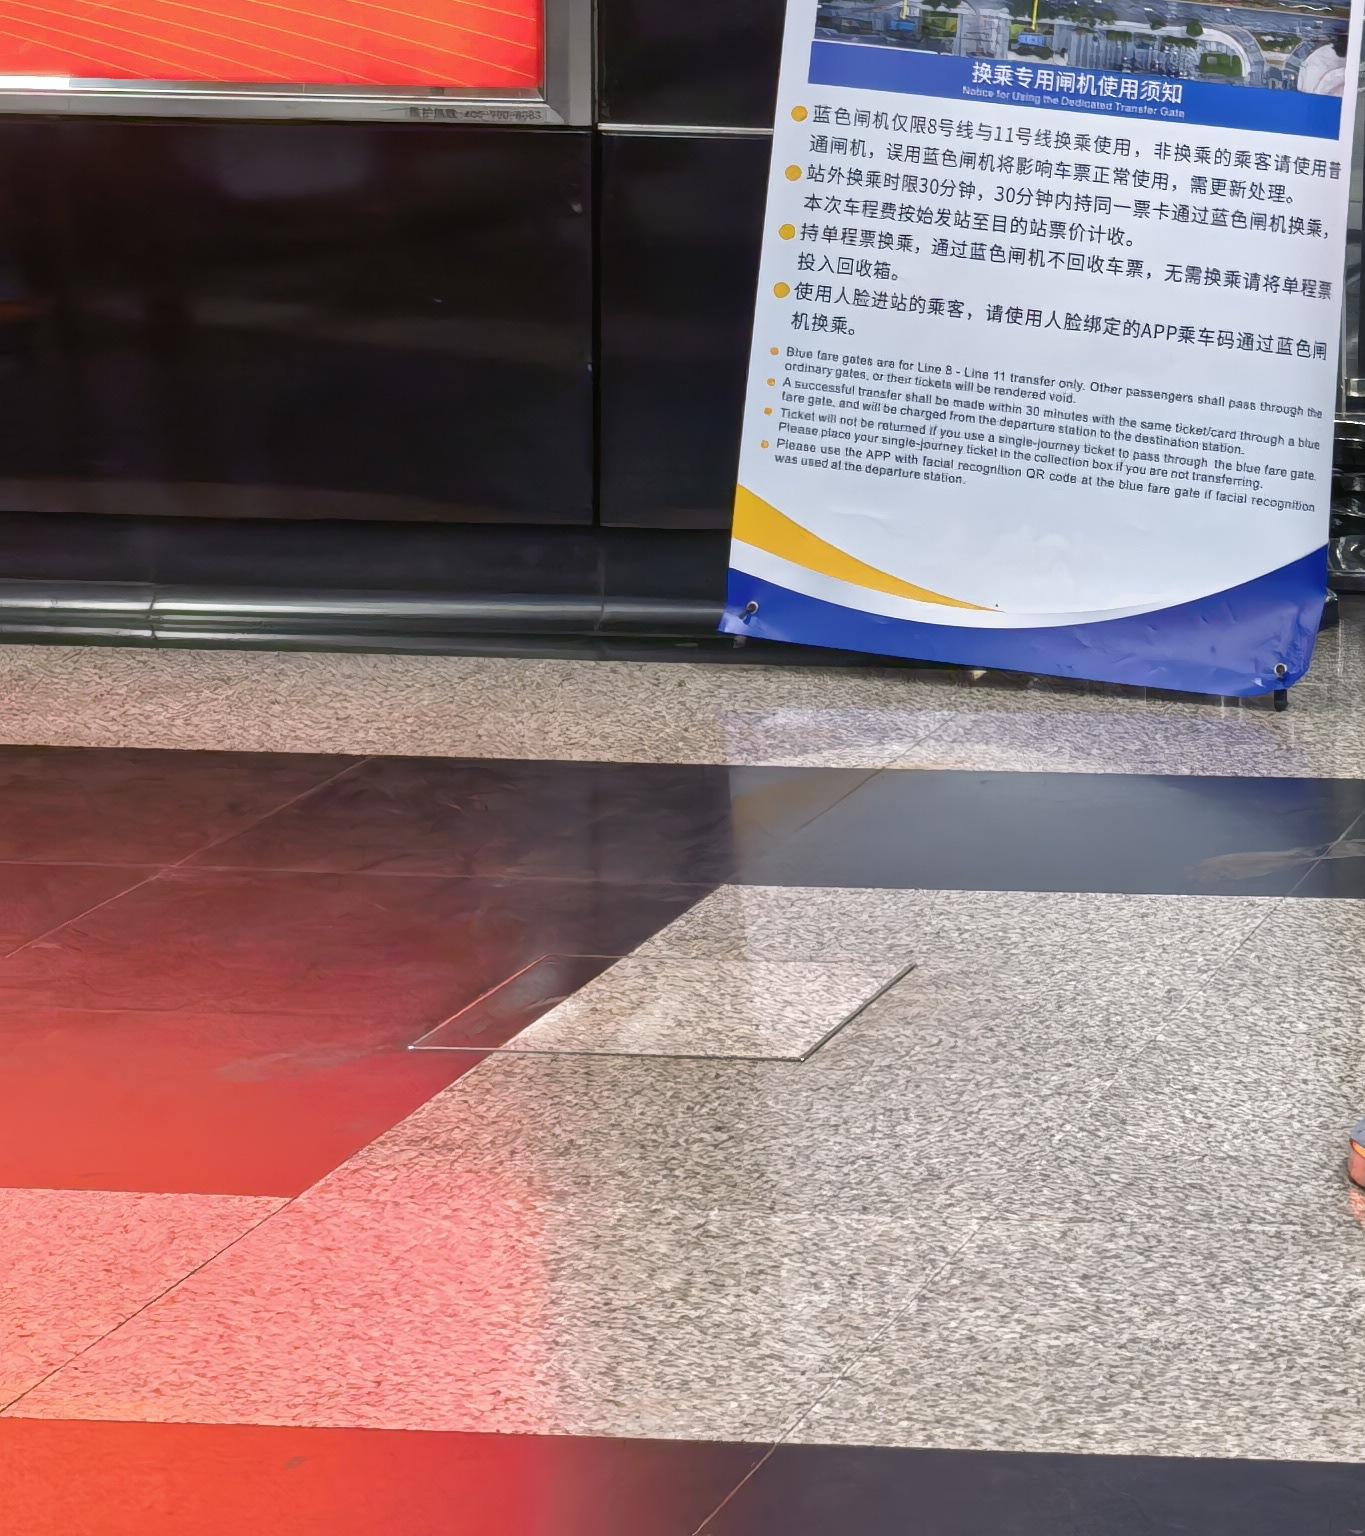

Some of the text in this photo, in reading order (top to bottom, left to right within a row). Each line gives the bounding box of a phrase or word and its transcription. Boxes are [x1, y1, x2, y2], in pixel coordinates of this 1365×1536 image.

[971, 61, 1184, 105] 换乘专用闸机使用须知
[797, 252, 902, 283] 投入回收箱。
[790, 311, 856, 336] 机换乘。
